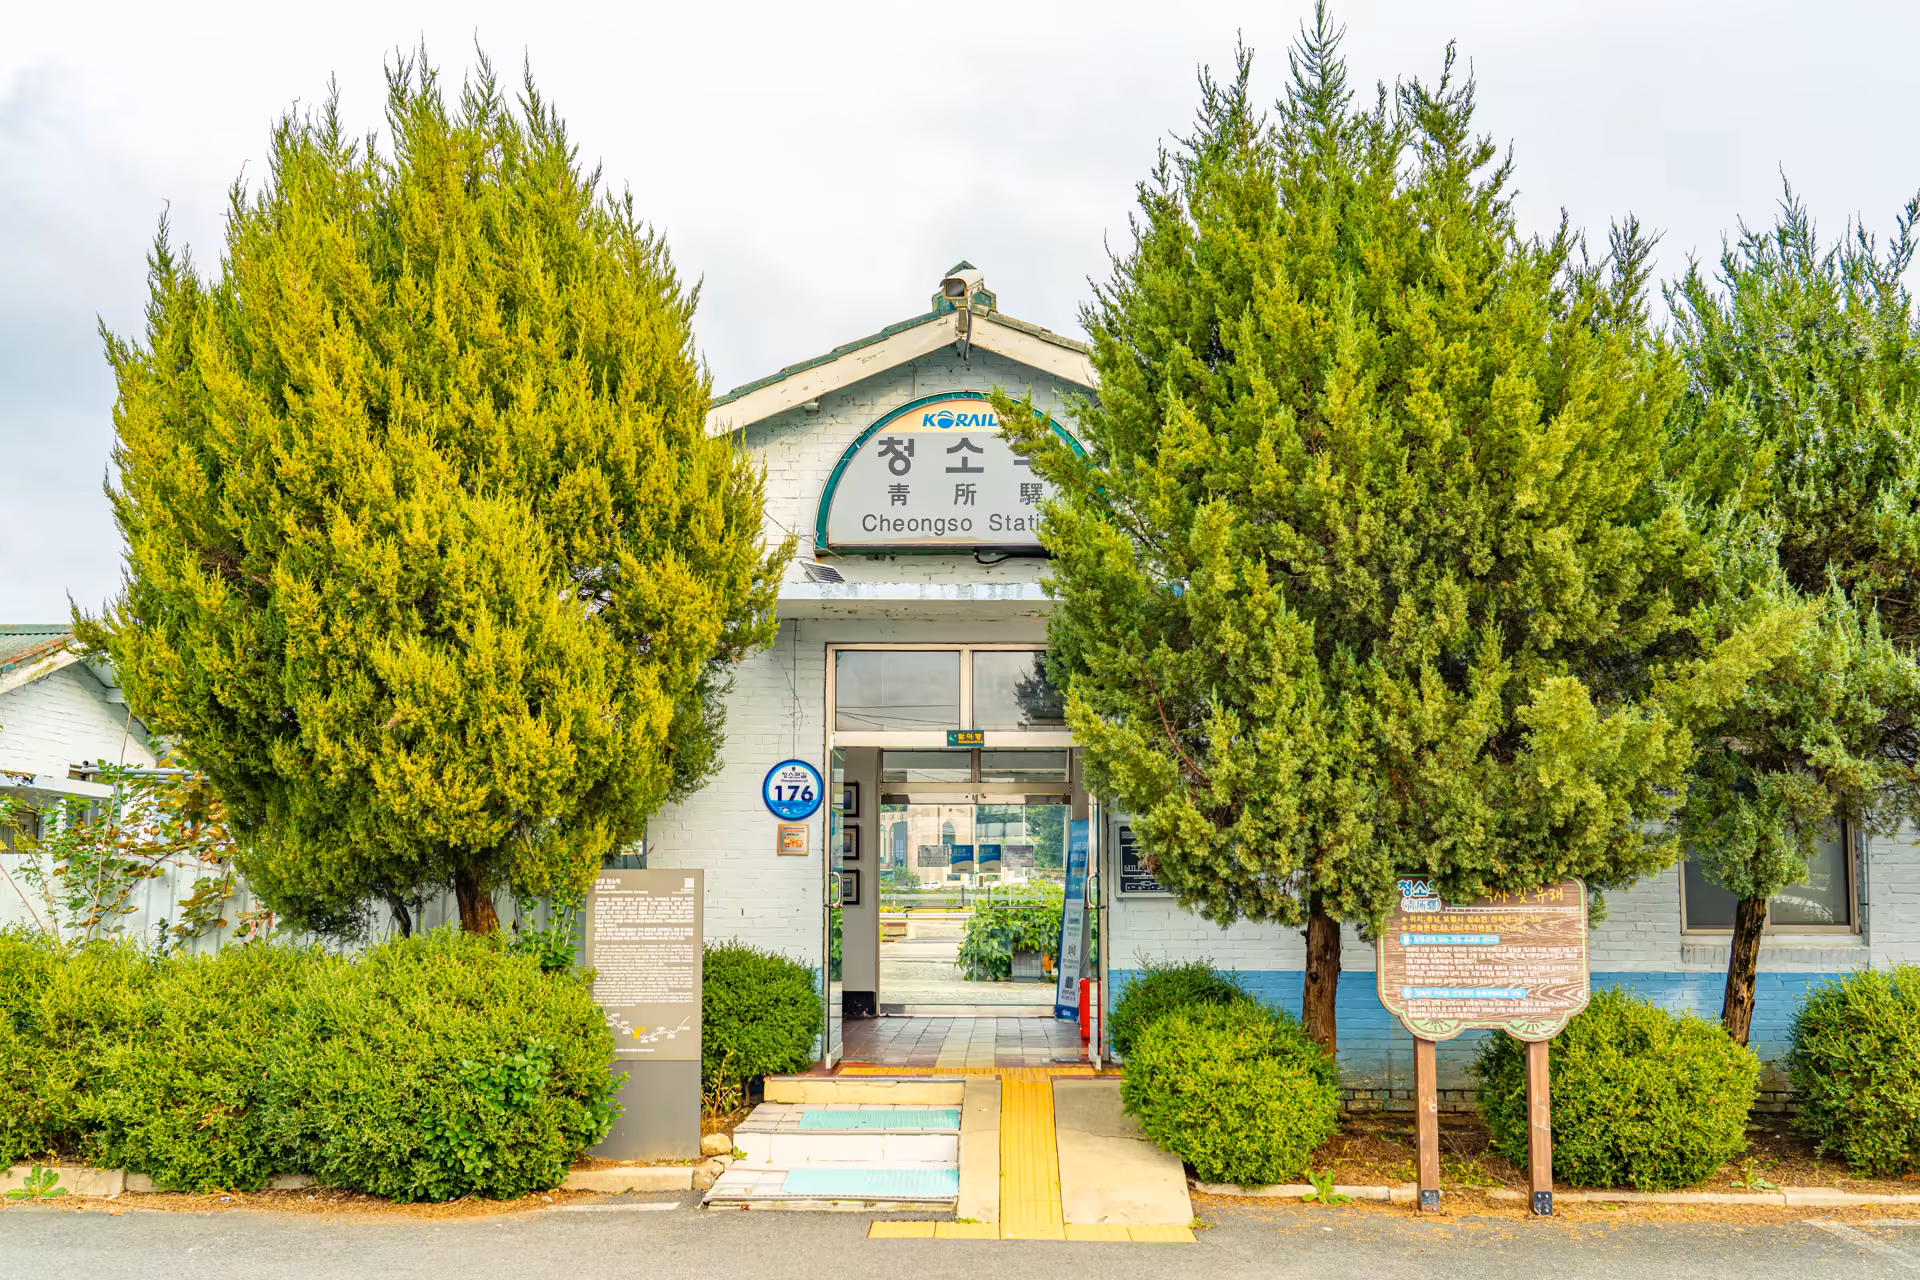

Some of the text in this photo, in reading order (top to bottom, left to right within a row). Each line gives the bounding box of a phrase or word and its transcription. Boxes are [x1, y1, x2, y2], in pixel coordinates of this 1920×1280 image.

[922, 410, 998, 429] KORAIL
[862, 513, 1041, 536] Cheongso Stati
[775, 785, 813, 802] 176
